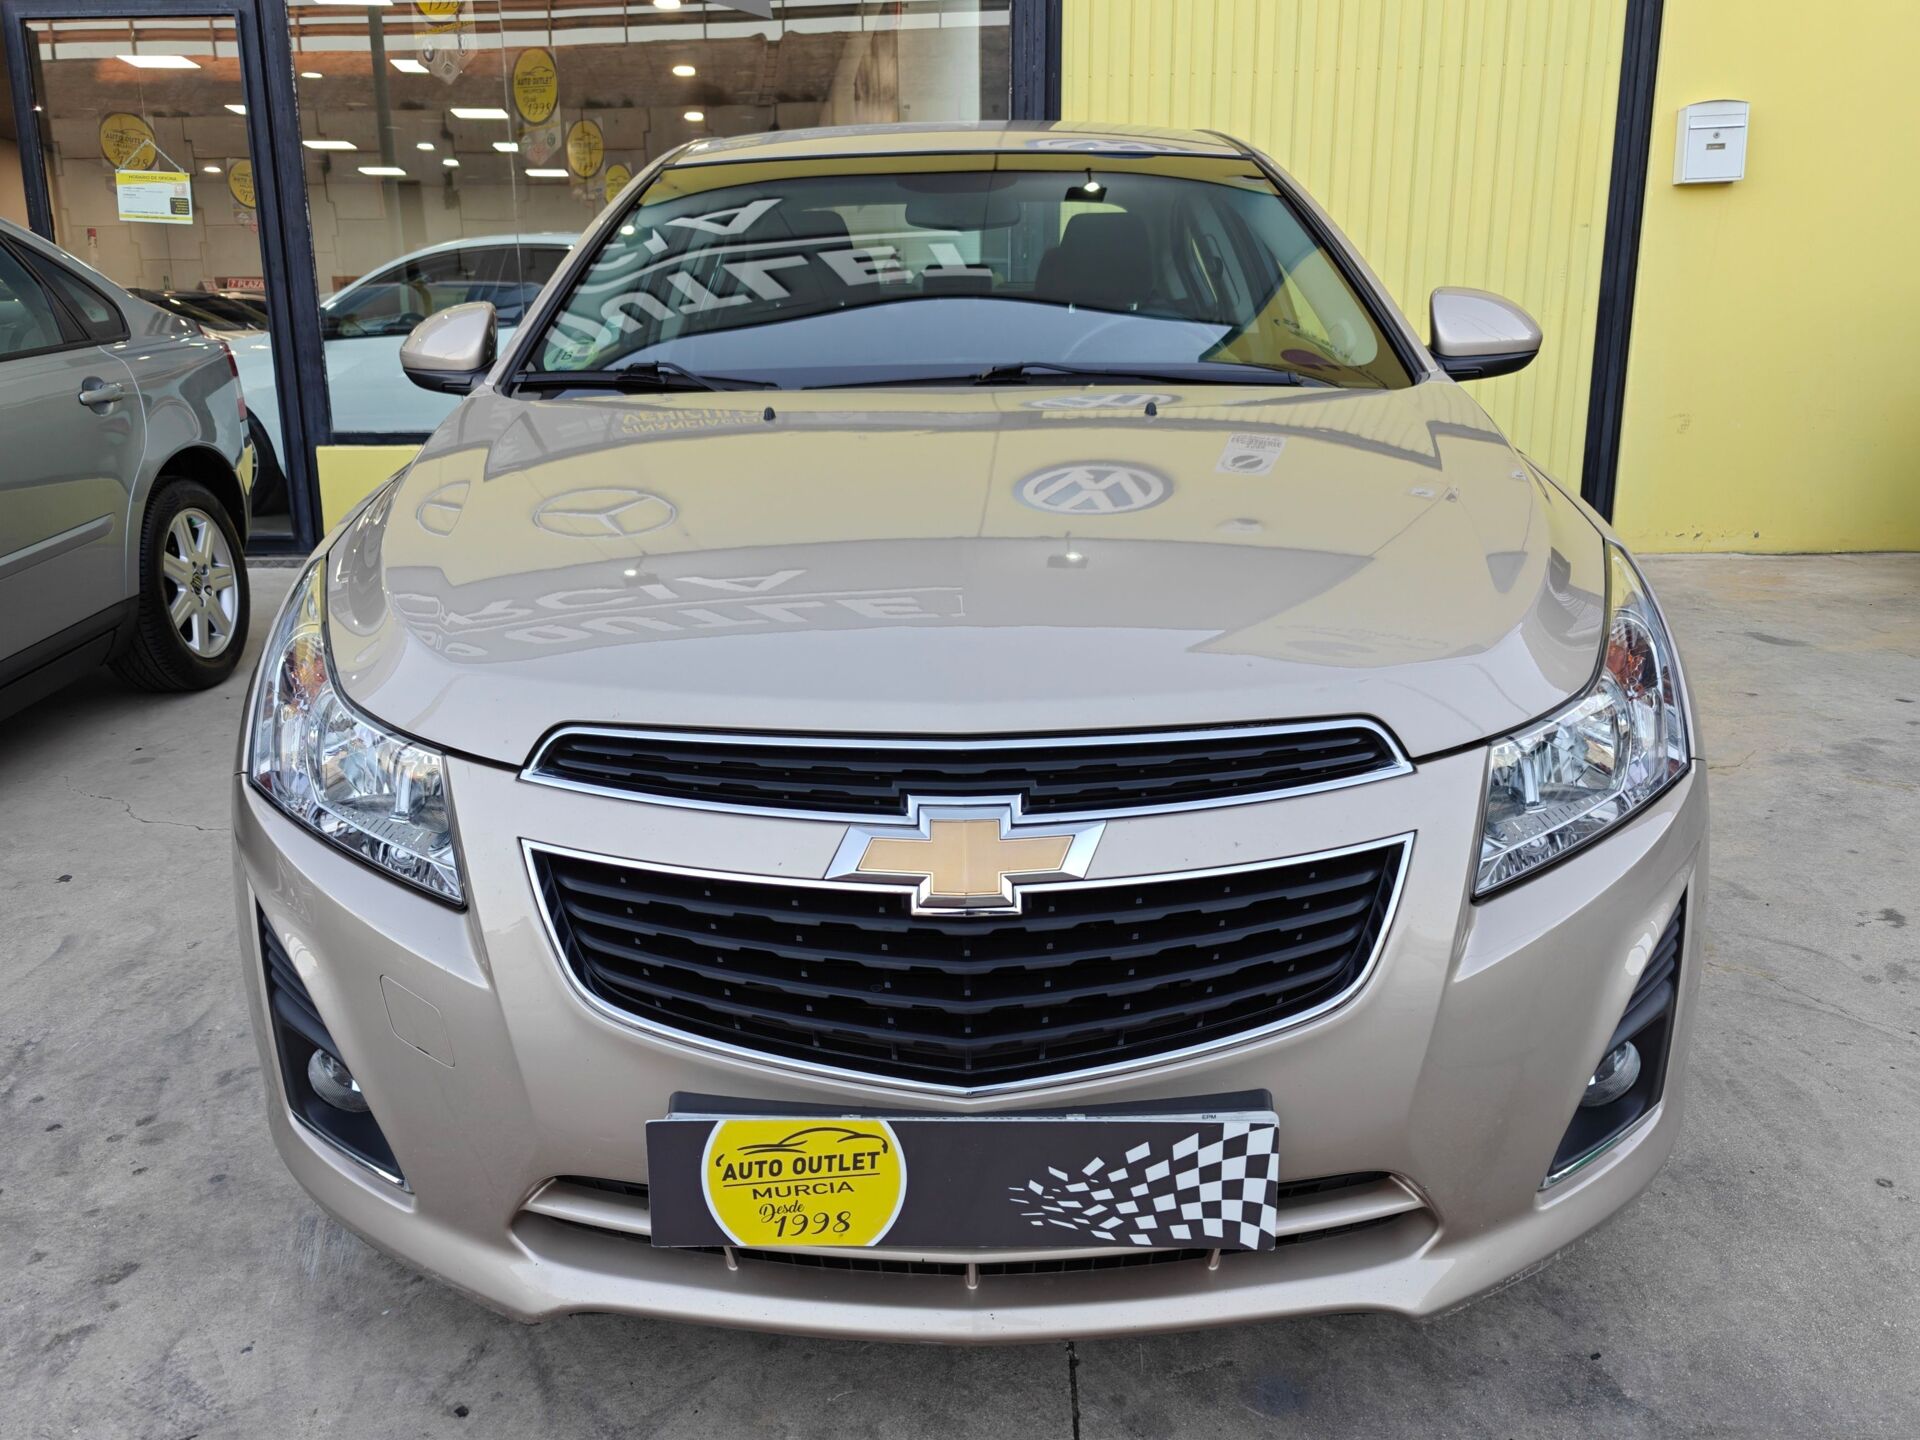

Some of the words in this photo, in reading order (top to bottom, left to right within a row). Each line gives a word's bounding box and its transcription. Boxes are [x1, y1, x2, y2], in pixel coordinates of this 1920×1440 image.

[792, 1151, 881, 1175] OUTLET
[752, 1181, 854, 1200] MURCIA
[759, 1200, 805, 1224] Desde
[774, 1210, 852, 1238] 1998
